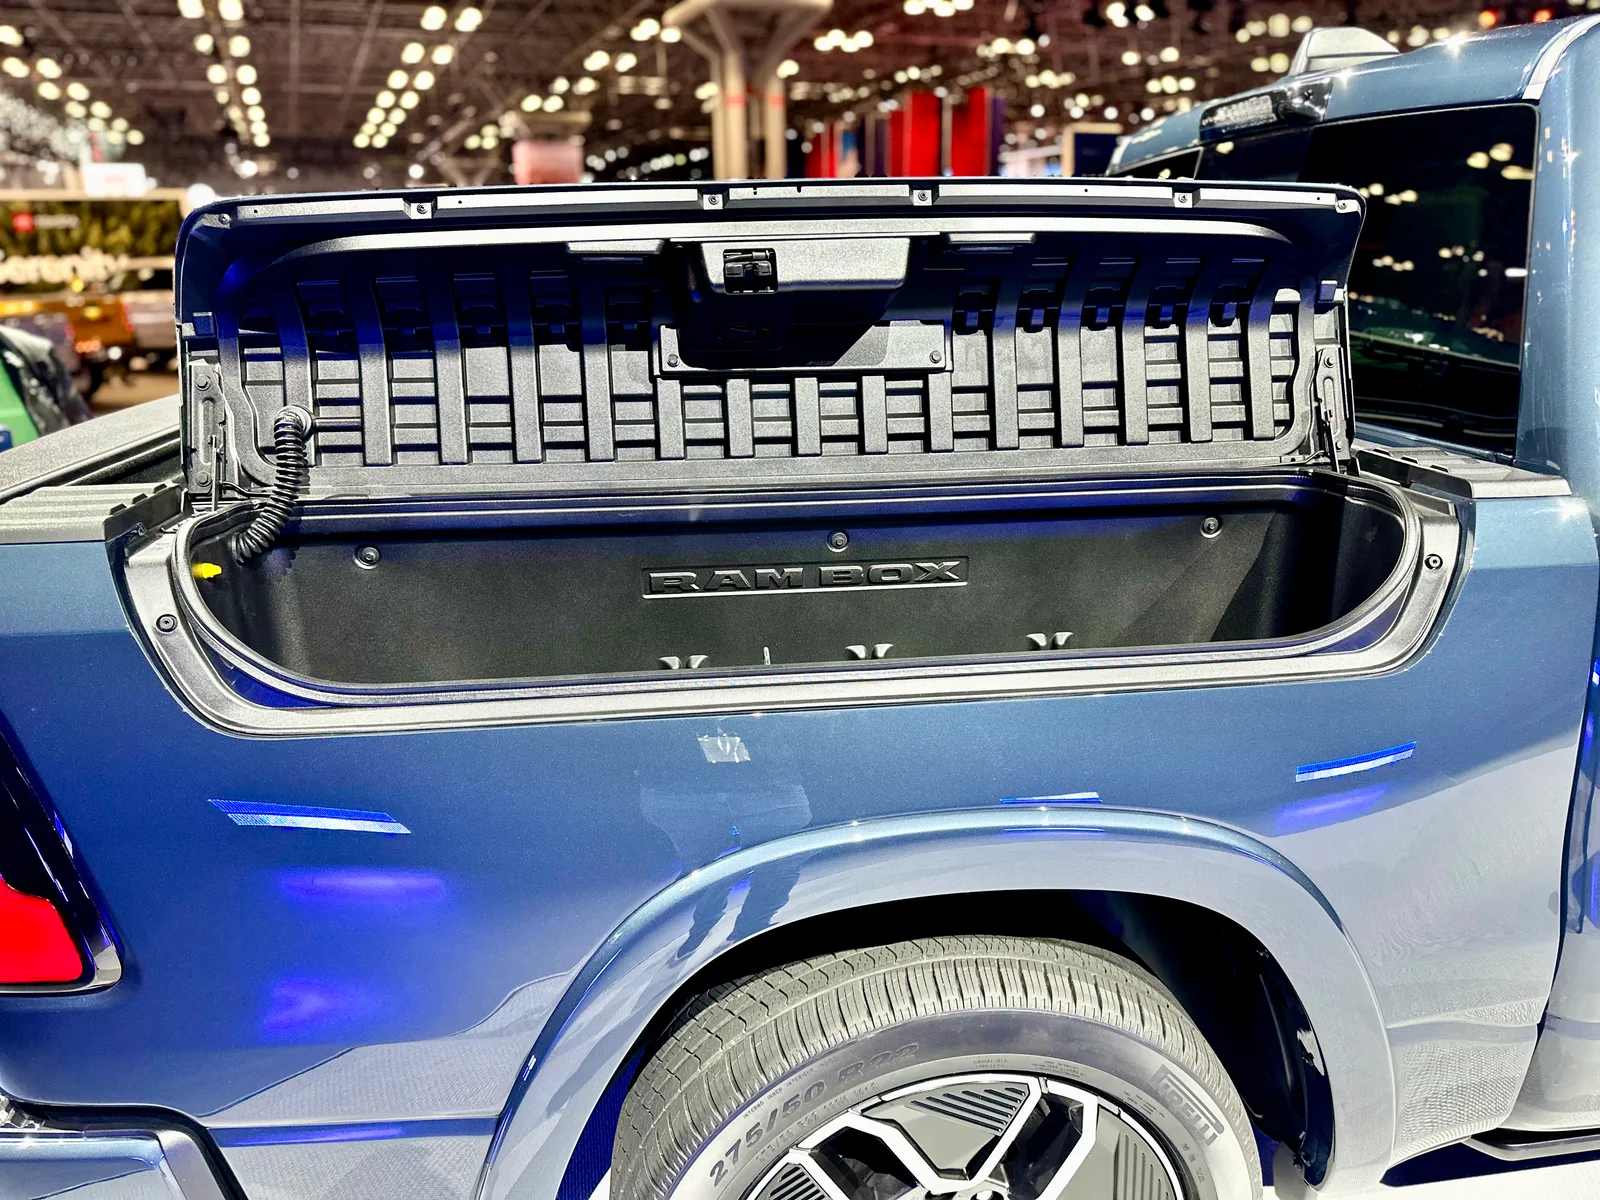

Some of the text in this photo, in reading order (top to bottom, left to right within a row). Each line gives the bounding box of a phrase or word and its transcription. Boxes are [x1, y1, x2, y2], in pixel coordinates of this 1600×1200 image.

[649, 561, 961, 593] RAM BOX
[709, 1043, 919, 1187] 275/50 R22
[1146, 1064, 1225, 1146] PIRELLI
